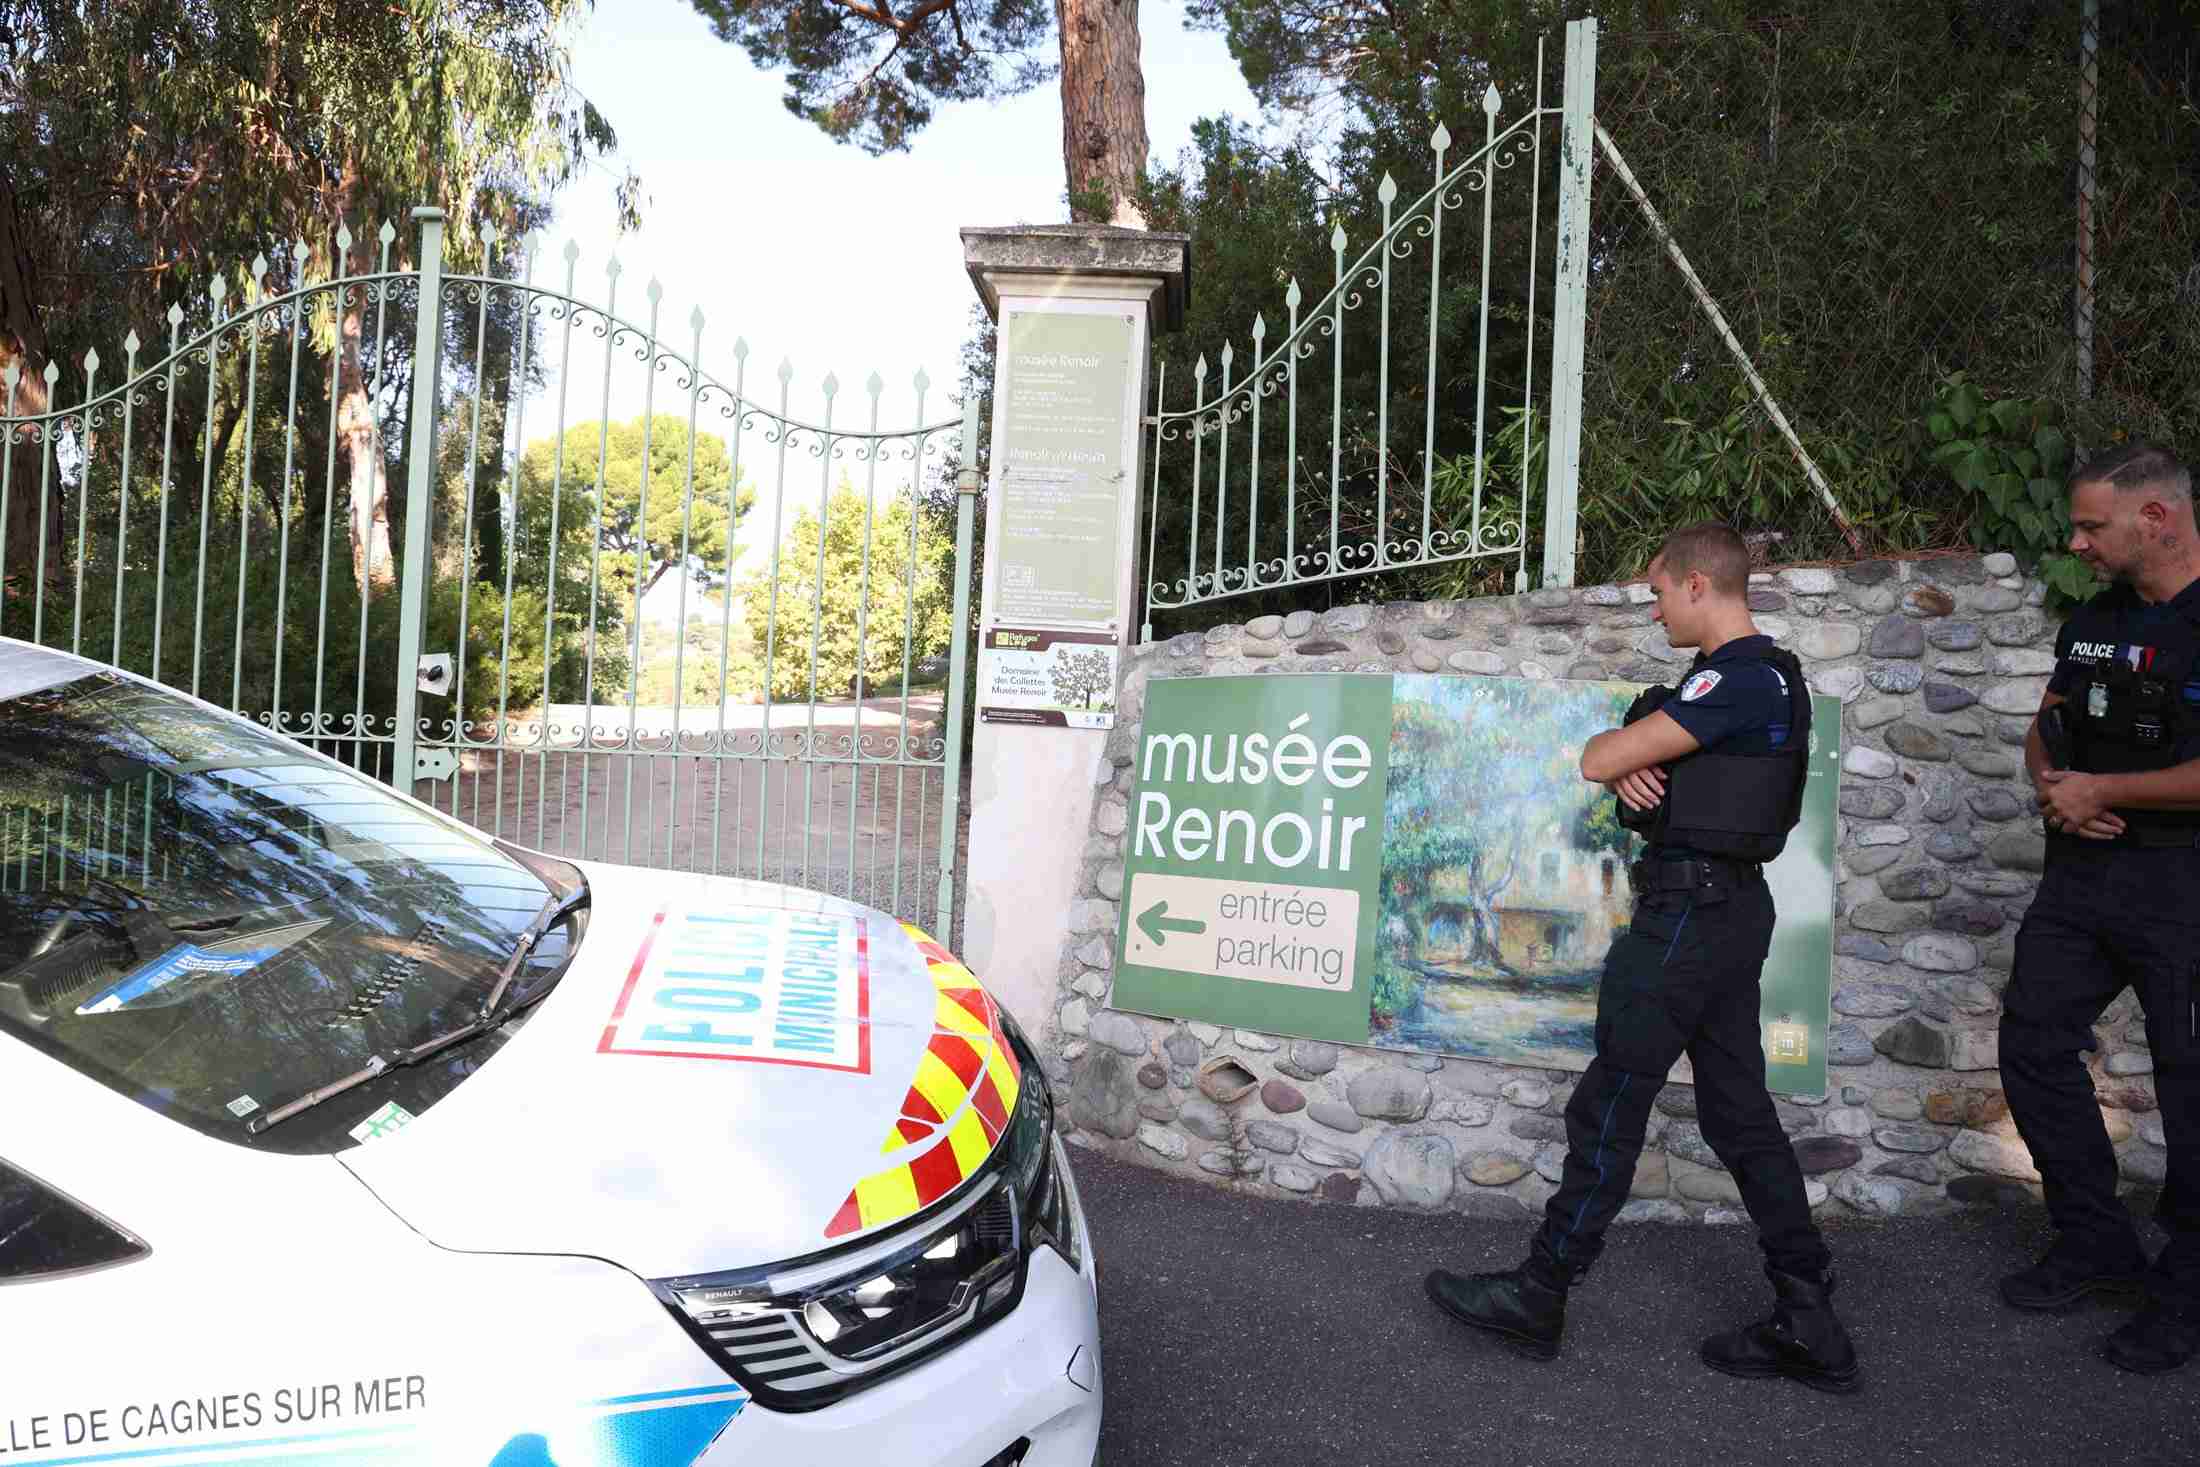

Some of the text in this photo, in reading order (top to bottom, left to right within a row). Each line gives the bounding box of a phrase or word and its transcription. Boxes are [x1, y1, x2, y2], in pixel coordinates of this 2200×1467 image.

[2071, 641, 2115, 658] POLICE
[1142, 712, 1372, 788] musée
[1134, 791, 1366, 871] Renoir
[1219, 889, 1328, 928] entrée
[774, 914, 839, 1054] MUNICIPALE
[1215, 934, 1344, 985] parking
[704, 1289, 743, 1300] RENAULT
[64, 1409, 109, 1446] DE
[121, 1392, 263, 1439] CAGNES
[273, 1384, 342, 1424] SUR
[354, 1374, 427, 1416] MER
